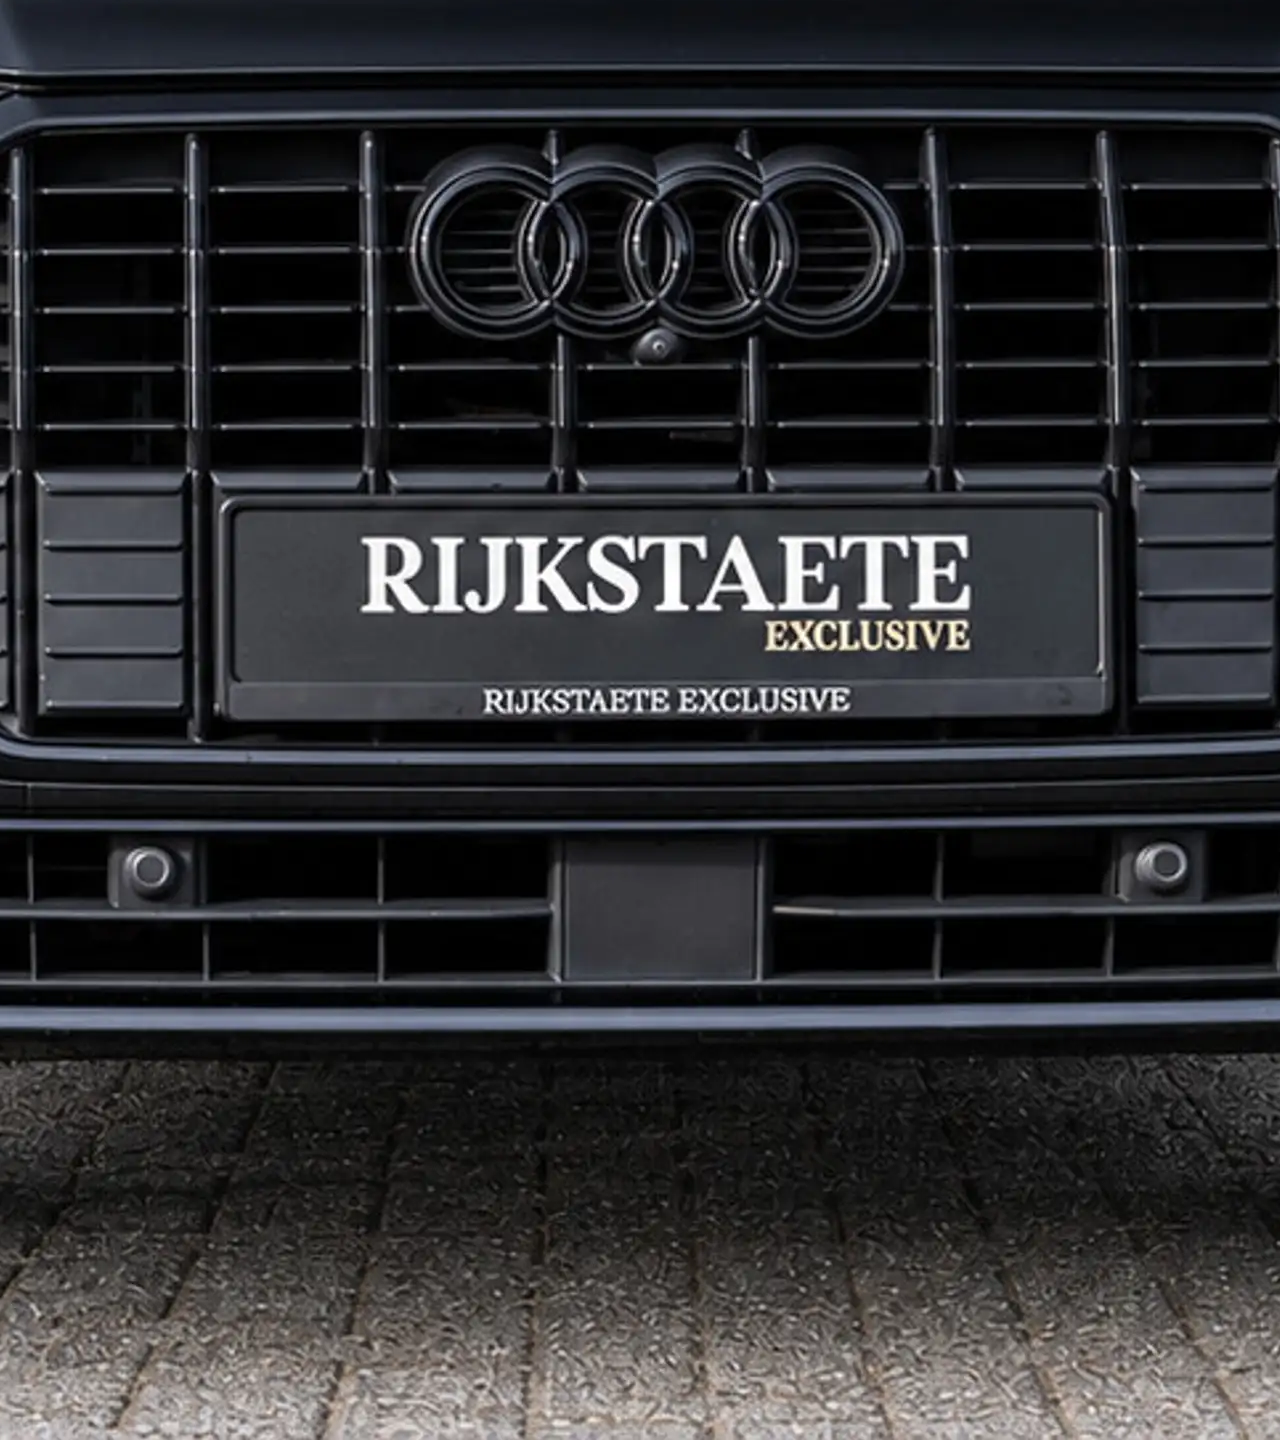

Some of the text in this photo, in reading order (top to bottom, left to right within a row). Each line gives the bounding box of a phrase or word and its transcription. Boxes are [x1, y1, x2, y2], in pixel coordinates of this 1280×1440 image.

[360, 534, 971, 614] RIJKSTAETE
[764, 619, 971, 652] EXCLUSIVE
[482, 686, 851, 715] RIJKSTAETE EXCLUSIVE
